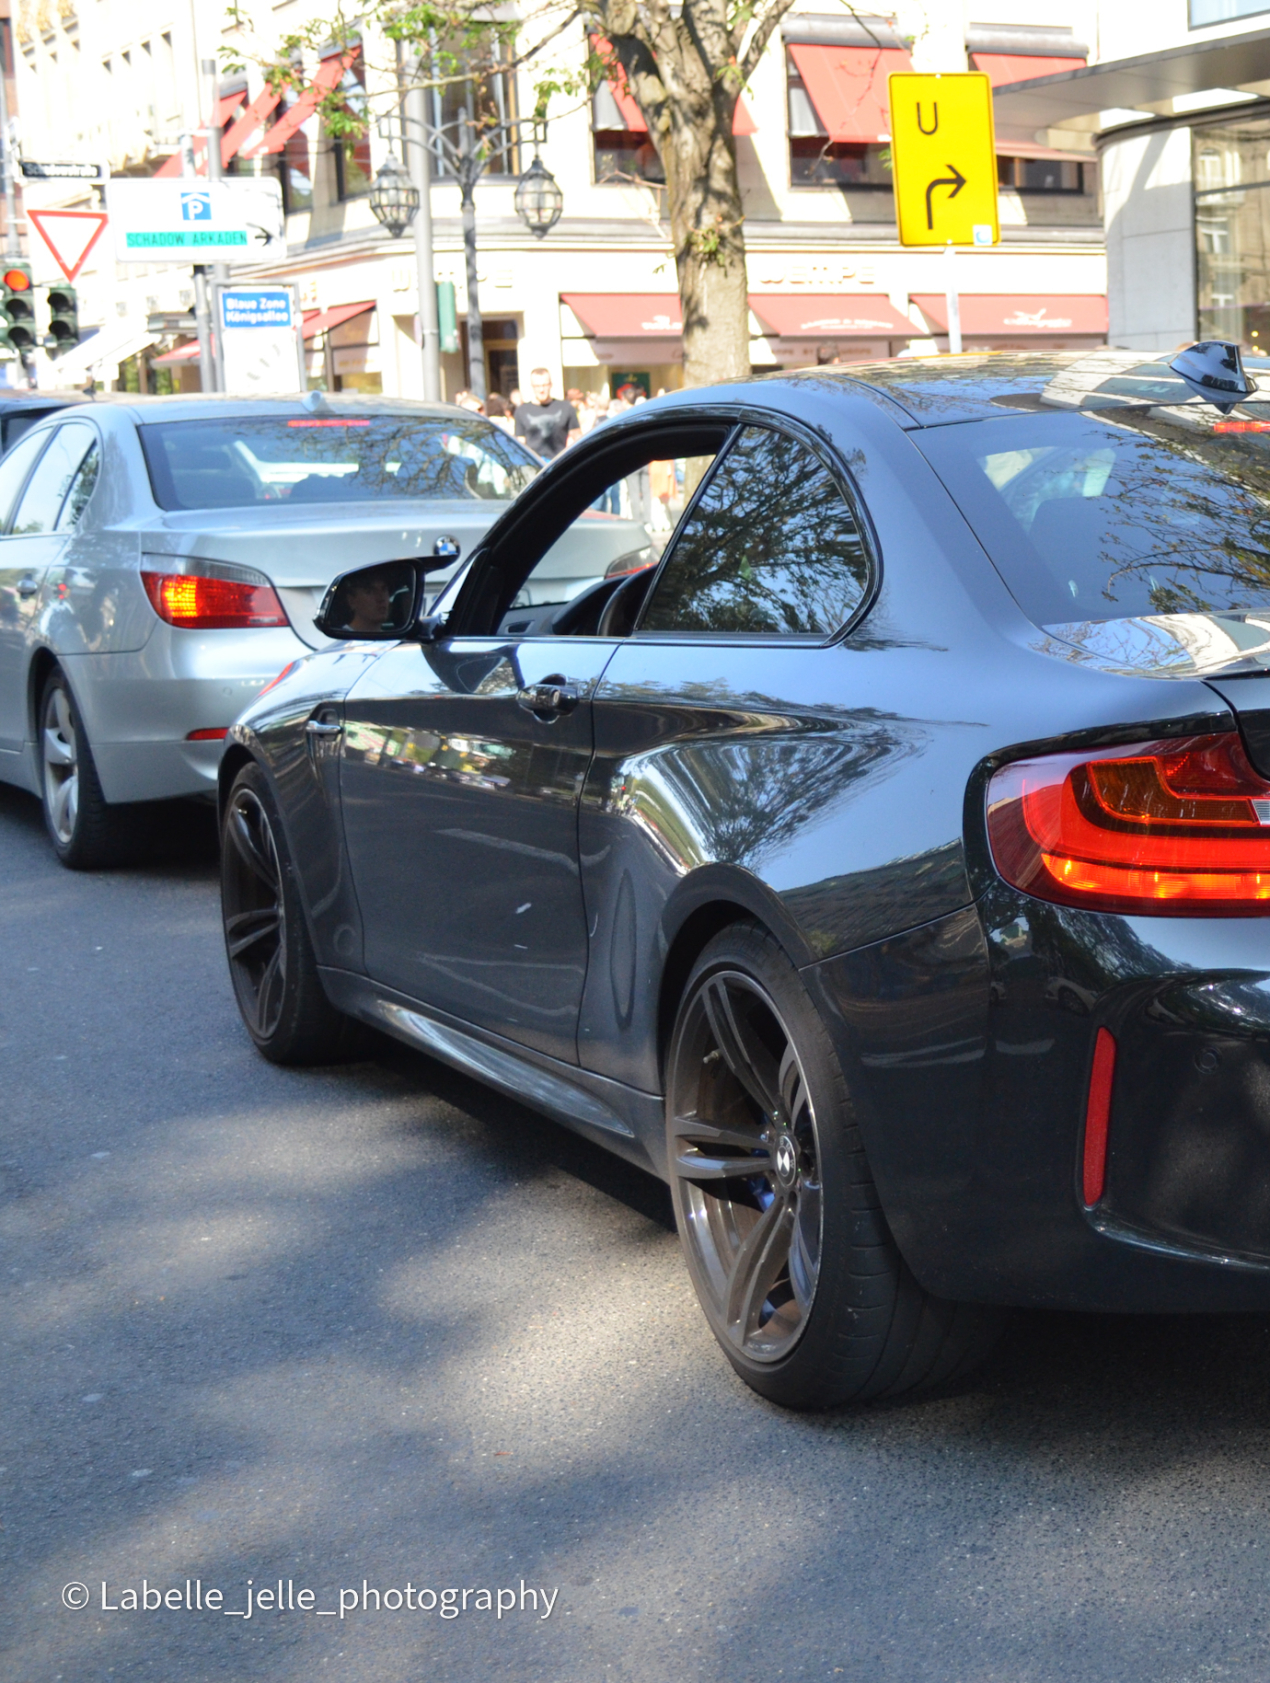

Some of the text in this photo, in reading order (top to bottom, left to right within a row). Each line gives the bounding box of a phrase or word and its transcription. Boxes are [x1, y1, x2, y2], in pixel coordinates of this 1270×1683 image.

[916, 102, 939, 135] U
[187, 201, 204, 221] P
[126, 231, 247, 247] SCHADOW ARKADEN
[226, 297, 286, 310] Blaue Zone
